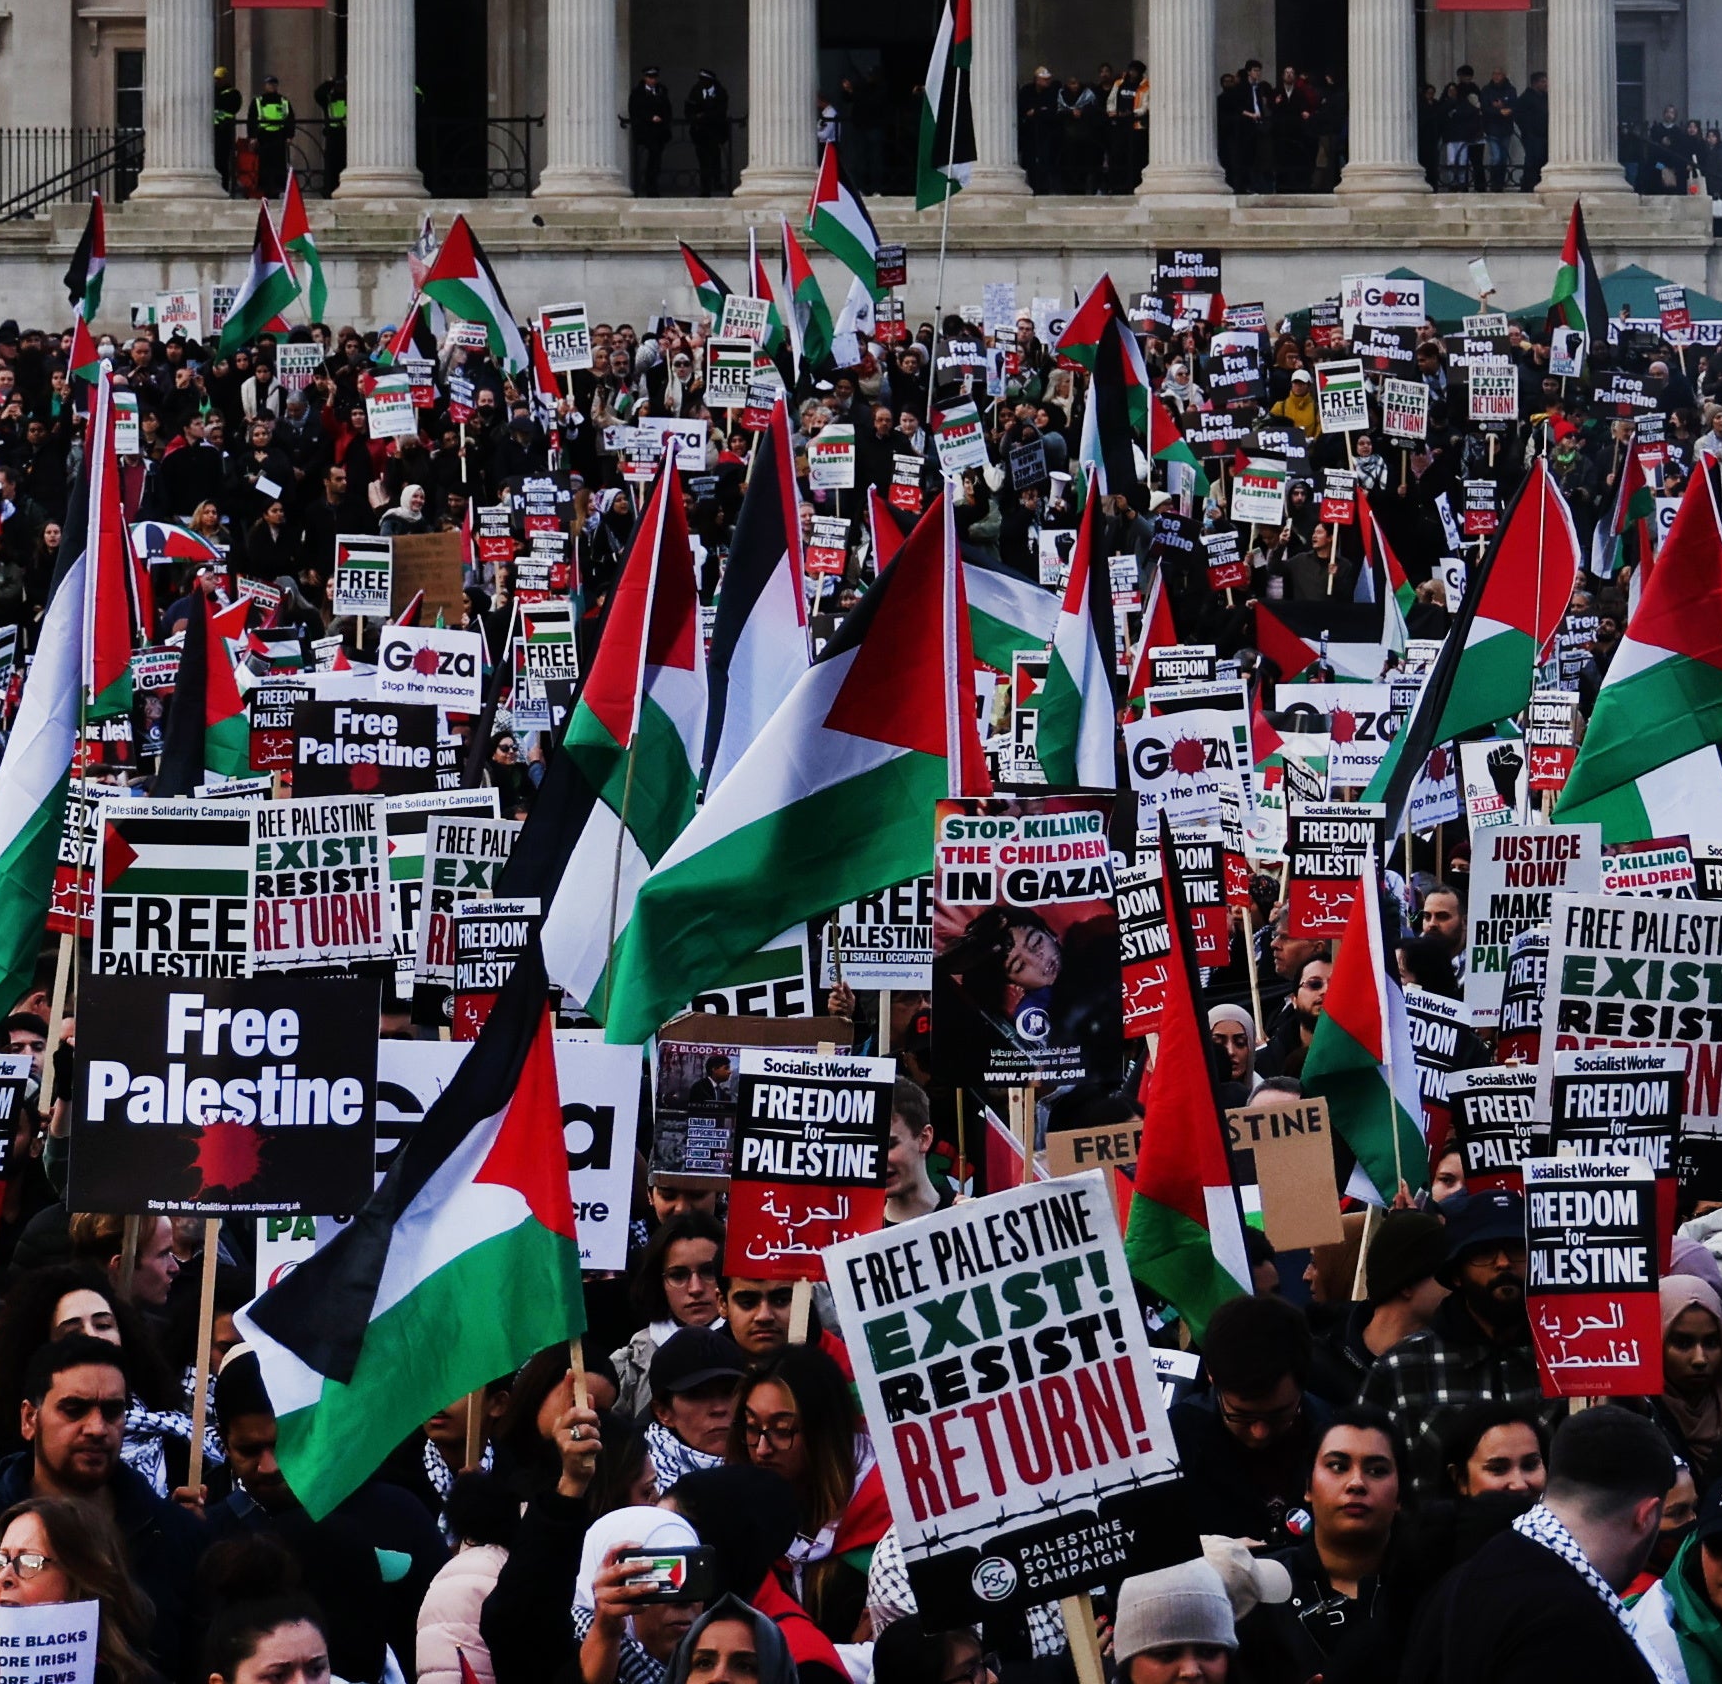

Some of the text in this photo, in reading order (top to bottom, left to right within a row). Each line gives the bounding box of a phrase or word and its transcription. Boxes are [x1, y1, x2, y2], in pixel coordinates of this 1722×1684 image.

[1175, 251, 1203, 264] Free
[1160, 264, 1218, 278] Palestine
[1364, 288, 1419, 308] Gza
[544, 335, 588, 353] FREE
[548, 348, 588, 359] PALESTINE
[949, 341, 977, 353] Free
[1473, 377, 1514, 388] EXIST!
[1612, 375, 1643, 391] Free
[1320, 390, 1364, 408] FREE
[1472, 397, 1514, 414] RETURN!
[1595, 389, 1656, 408] Palestine
[1322, 405, 1364, 418] PALESTINE
[337, 569, 389, 590] FREE
[336, 589, 388, 600] PALESTINE
[384, 641, 475, 679] Gza
[382, 681, 475, 697] Stop the massacre
[334, 708, 398, 735] Free
[299, 739, 430, 768] Palestine
[292, 803, 374, 835] PALESTINE
[946, 815, 1100, 840] STOP KILLING
[256, 836, 378, 871] EXIST!
[941, 840, 1106, 865] THE CHILDREN
[1493, 835, 1580, 861] JUSTICE
[256, 867, 379, 898] RESIST!
[947, 867, 1111, 901] IN GAZA
[1505, 862, 1566, 887] NOW!
[100, 897, 246, 952] FREE
[254, 893, 381, 951] RETURN!
[167, 993, 299, 1057] Free
[984, 1069, 1085, 1082] WWW.PFBUK.COM
[87, 1060, 364, 1126] Palestine
[847, 1190, 1098, 1312] FREE PALESTINE
[863, 1250, 1113, 1375] EXIST!
[878, 1309, 1127, 1423] RESIST!
[893, 1355, 1152, 1522] RETURN!
[1020, 1519, 1123, 1560] PALESTINE
[1024, 1530, 1136, 1574] SOLIDARITY
[1027, 1549, 1127, 1589] CAMPAIGN
[25, 1631, 88, 1647] BLACKS
[36, 1652, 76, 1666] IRISH
